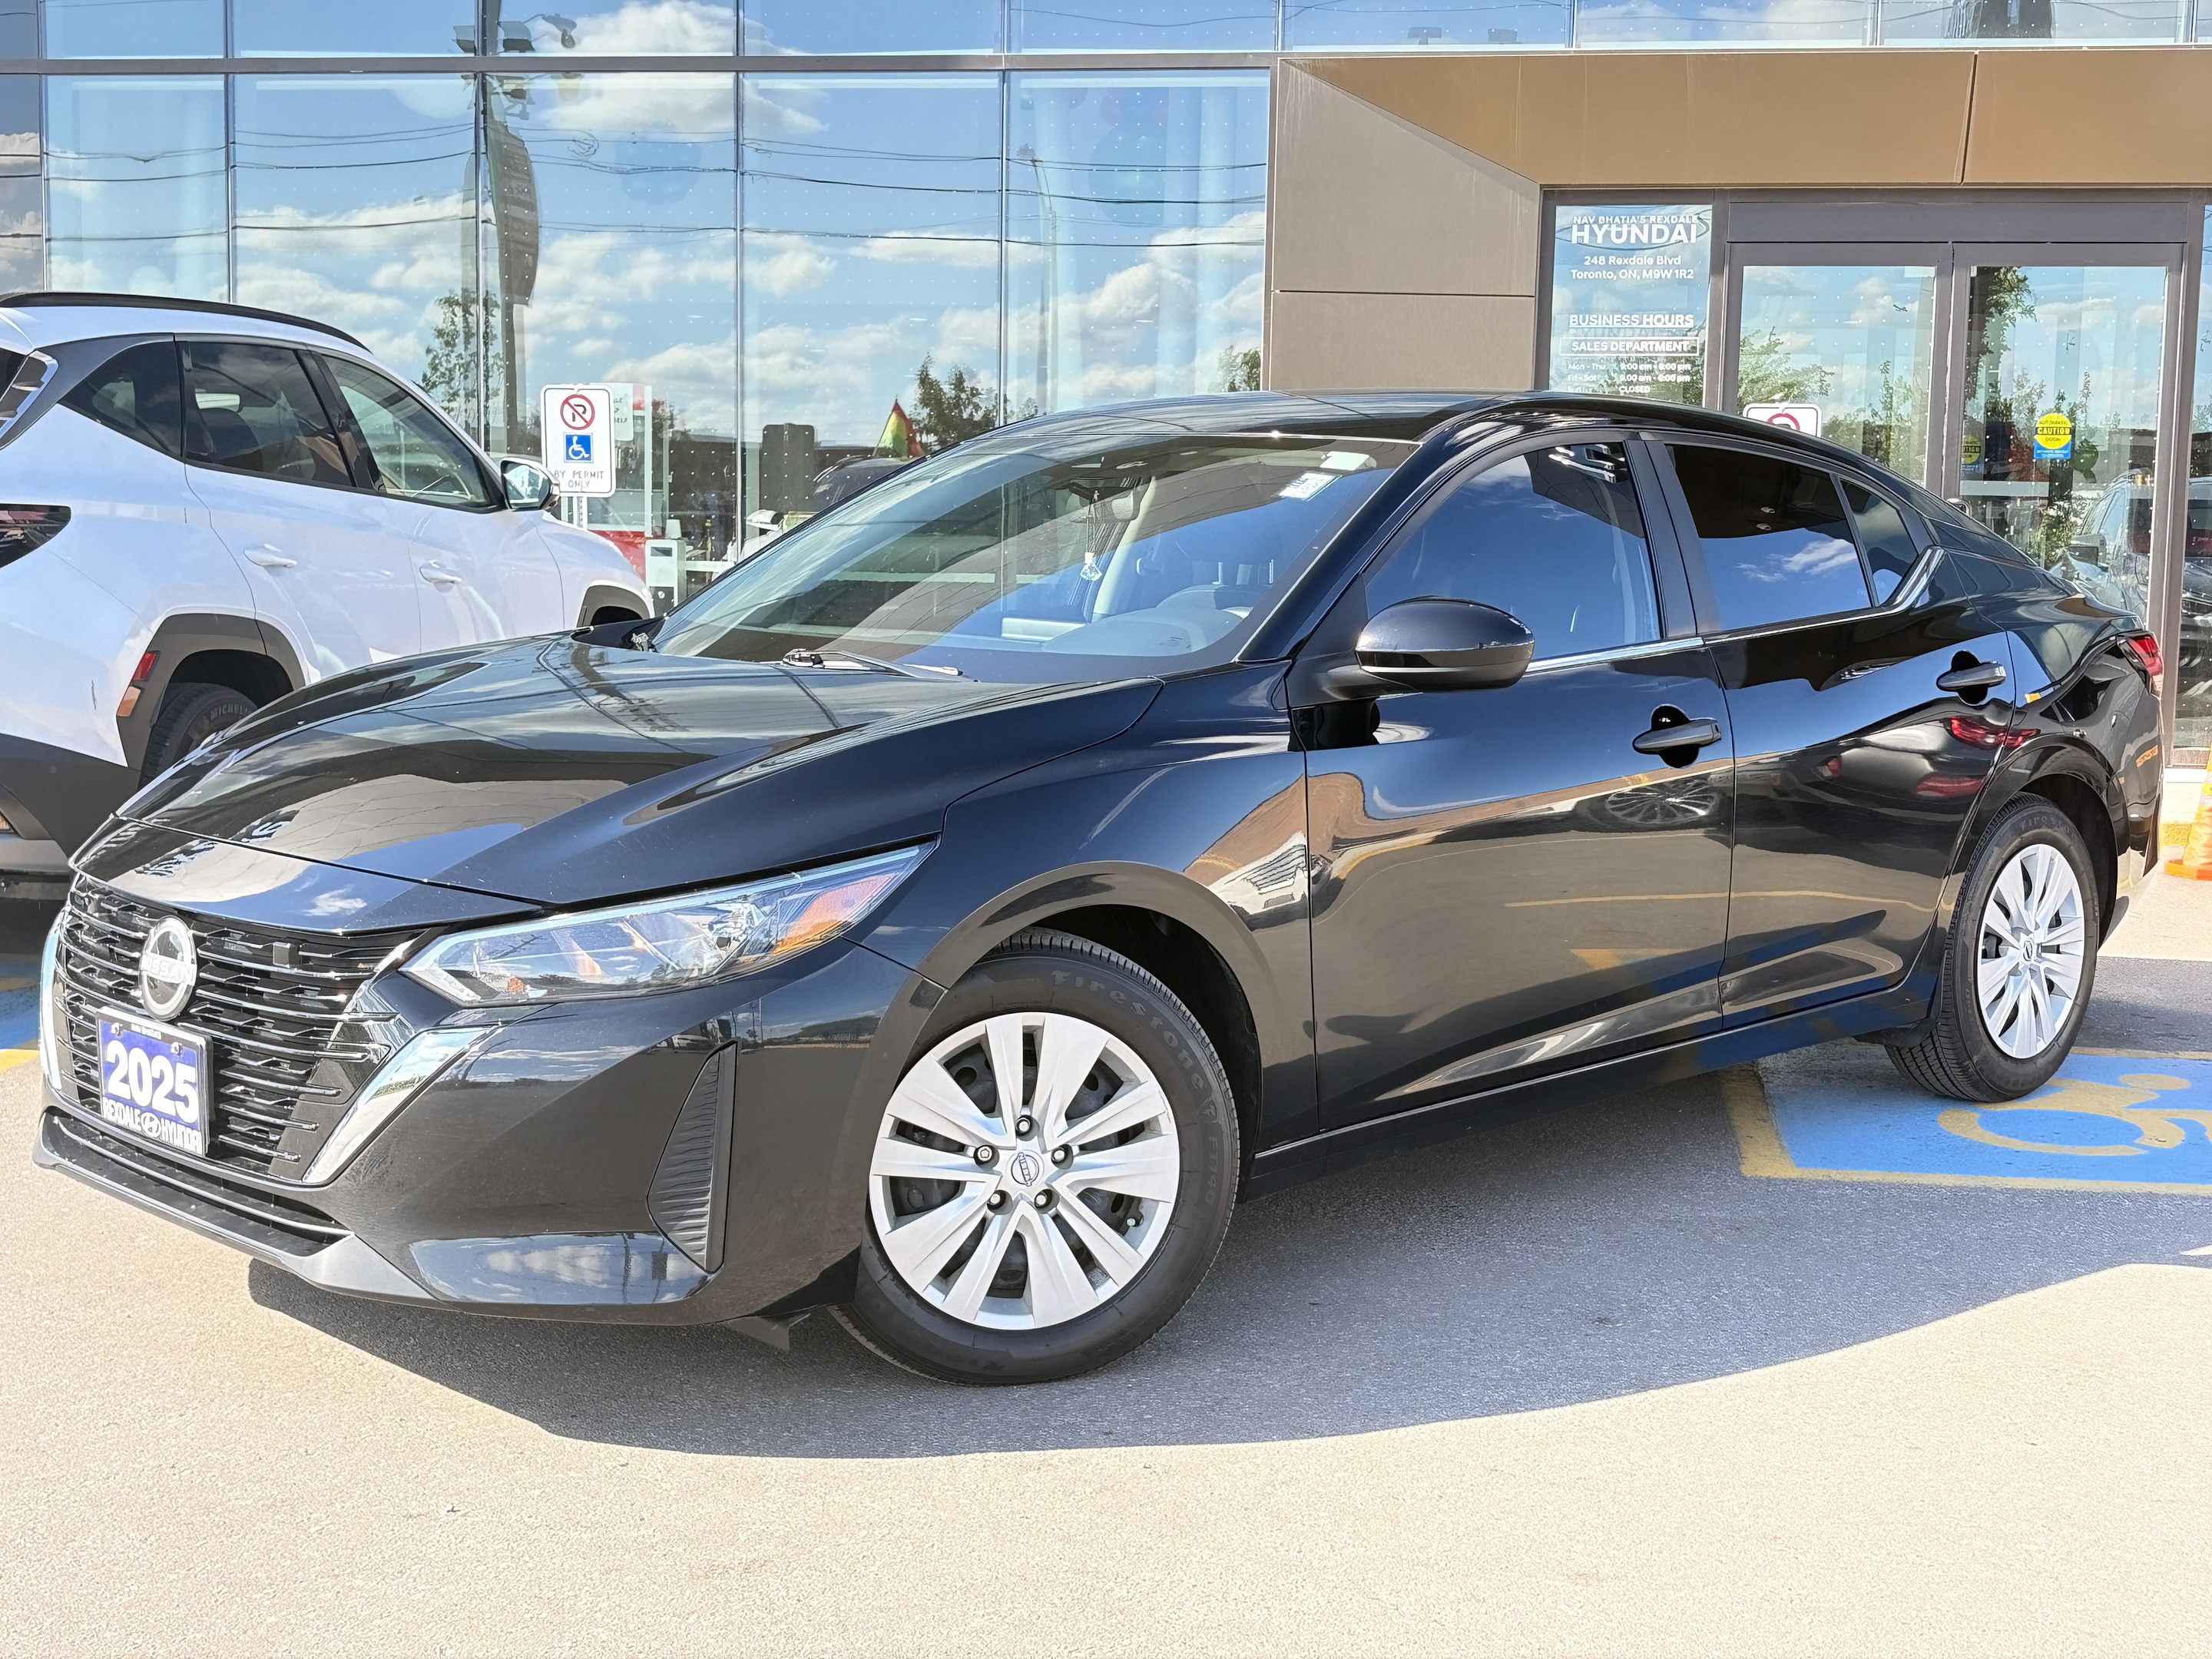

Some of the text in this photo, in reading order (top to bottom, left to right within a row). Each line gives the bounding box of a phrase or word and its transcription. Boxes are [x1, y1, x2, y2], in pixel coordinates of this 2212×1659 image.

[1573, 216, 1595, 224] NAV
[1650, 216, 1699, 224] REXDALE
[1571, 224, 1697, 244] HYUNDAI
[1584, 255, 1681, 266] 248 Rexdale Blvd
[1571, 270, 1694, 280] Toronto, ON, M9W 1R2
[1568, 314, 1694, 326] BUSINESS HOURS
[1571, 340, 1690, 352] SALES DEPARTMENT
[1619, 385, 1651, 394] CLOSED
[555, 470, 604, 479] BY PERMIT
[568, 479, 591, 488] ONLY
[1050, 970, 1204, 1091] Firestone
[106, 1039, 199, 1124] 2025
[101, 1096, 141, 1132] REXDALE
